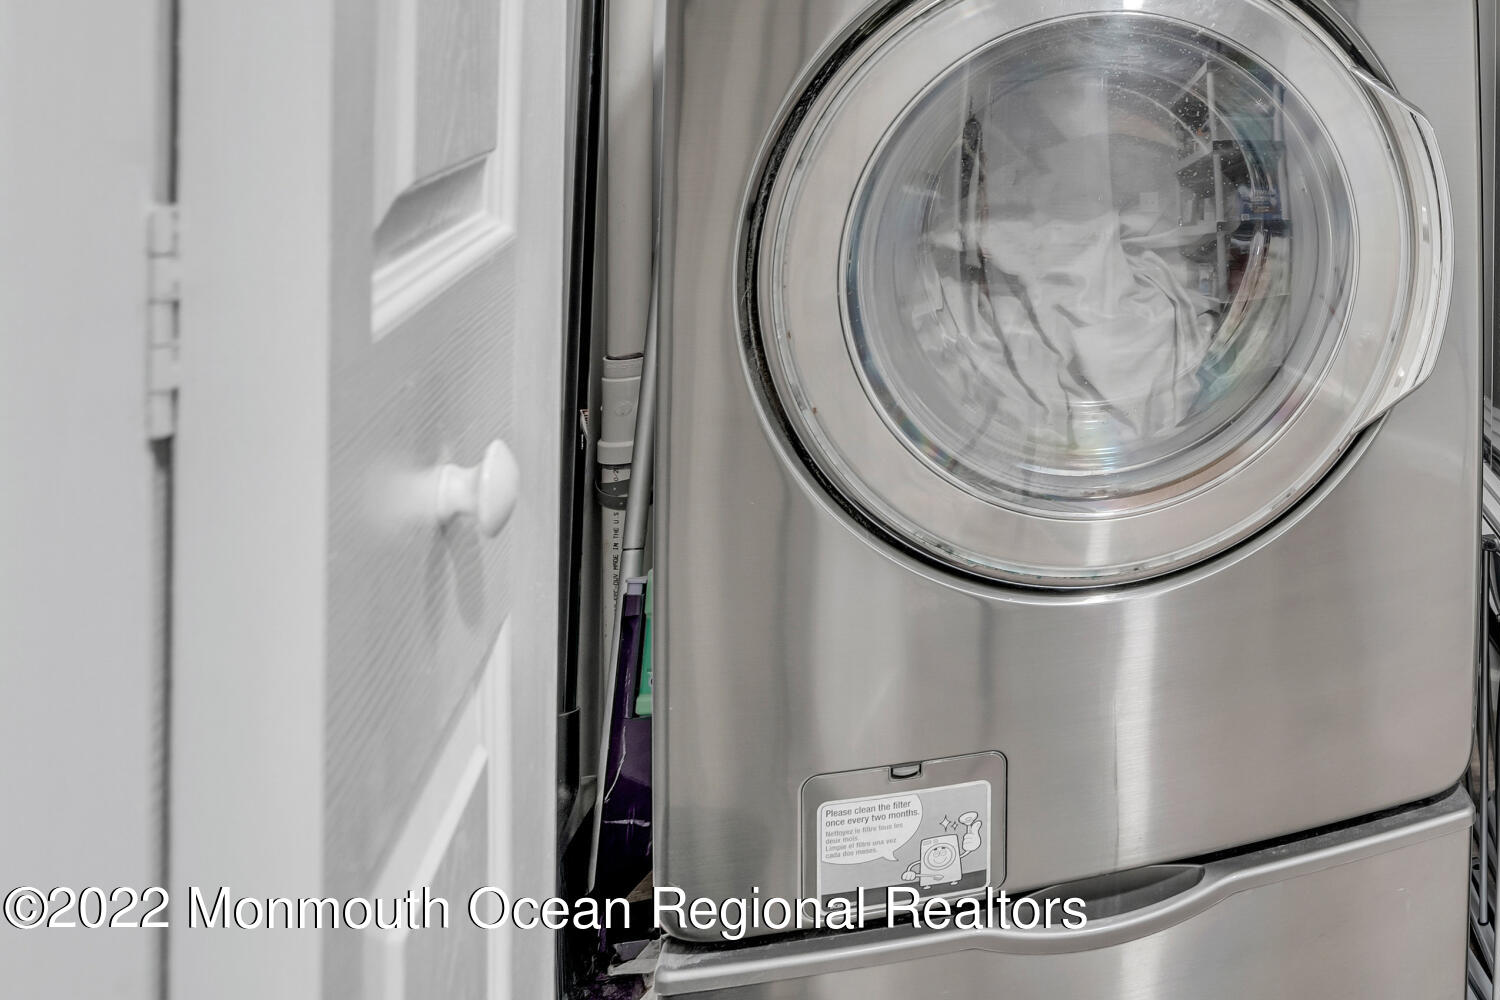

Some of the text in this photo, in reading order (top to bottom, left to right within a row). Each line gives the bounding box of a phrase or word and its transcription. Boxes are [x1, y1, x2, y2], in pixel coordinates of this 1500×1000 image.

[825, 800, 911, 818] Please clean the filter
[825, 809, 920, 828] once every two months.
